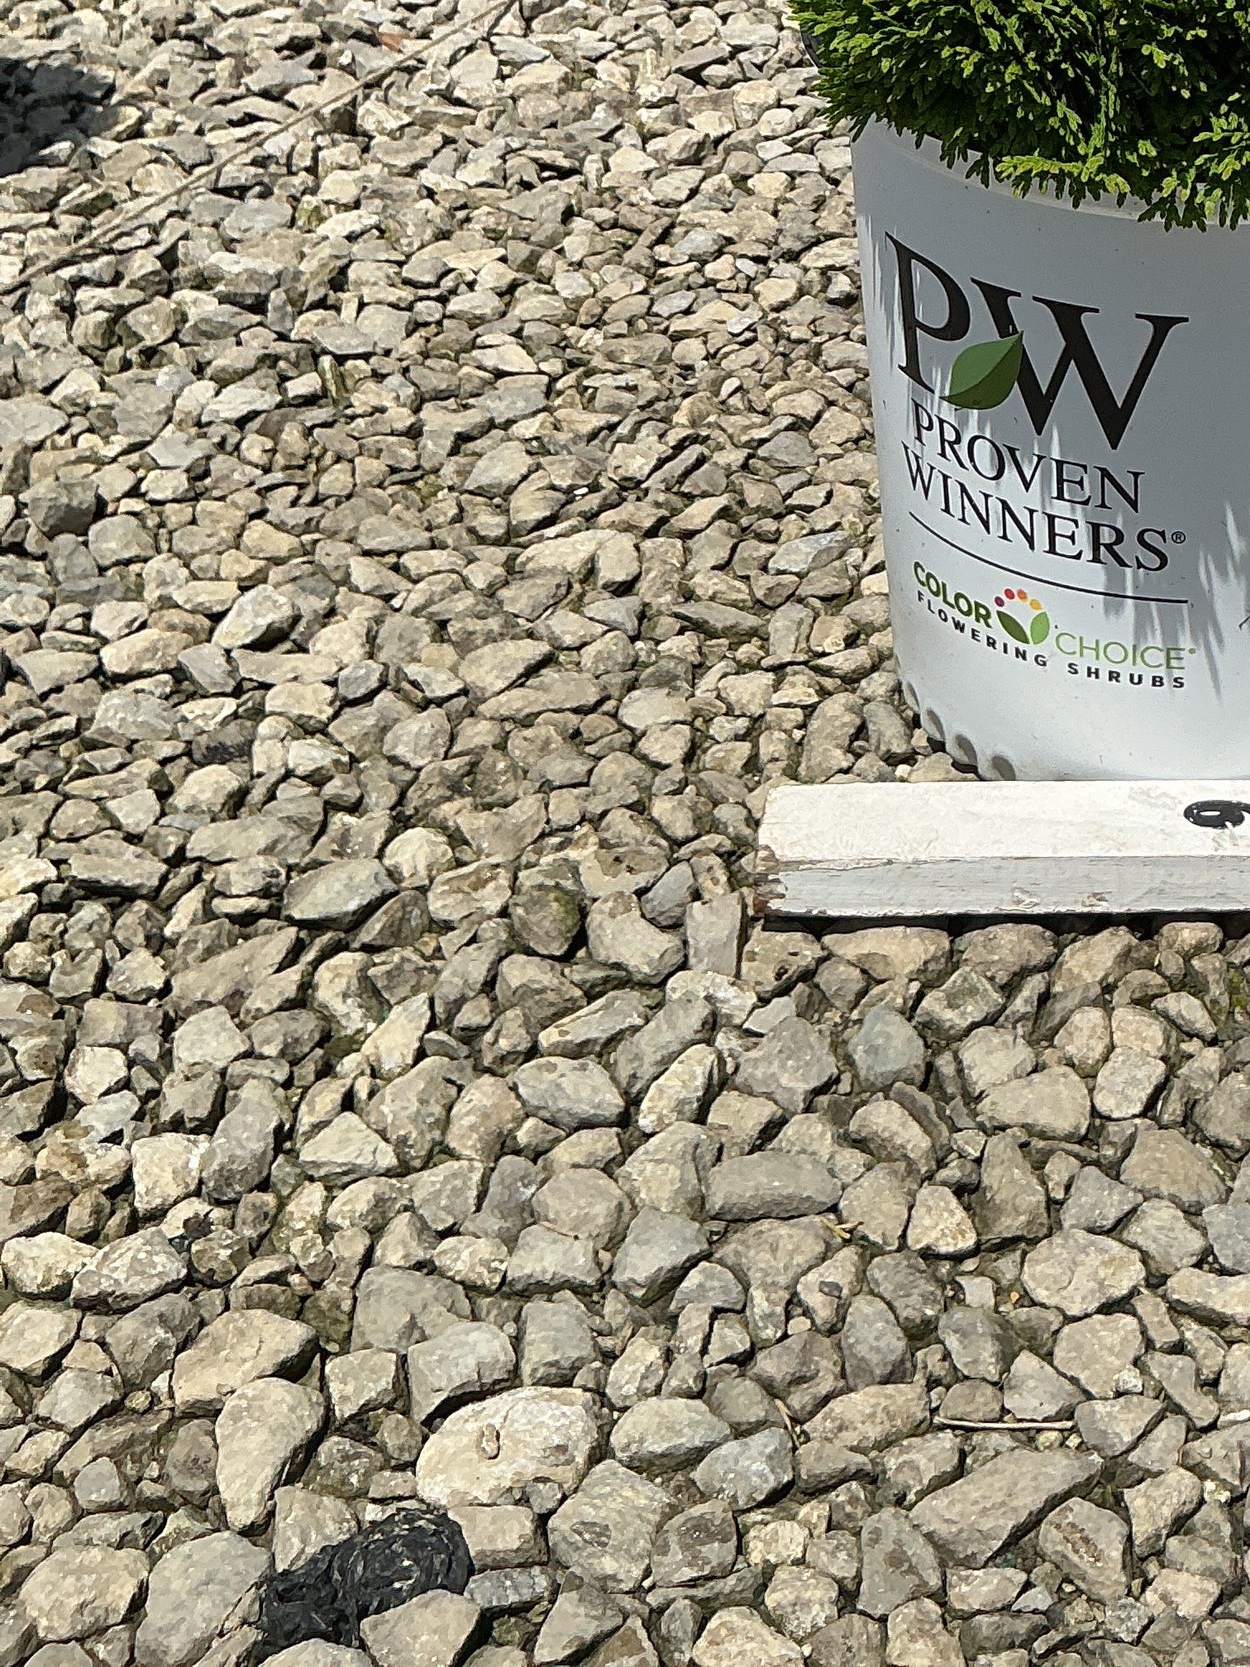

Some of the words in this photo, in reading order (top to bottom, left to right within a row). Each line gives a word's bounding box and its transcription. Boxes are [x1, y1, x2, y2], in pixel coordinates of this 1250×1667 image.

[884, 230, 1190, 450] PW
[911, 398, 1145, 514] PROVEN
[913, 561, 993, 629] COLOR
[917, 590, 1048, 668] FLOWERING
[1067, 662, 1186, 690] SHRUBS
